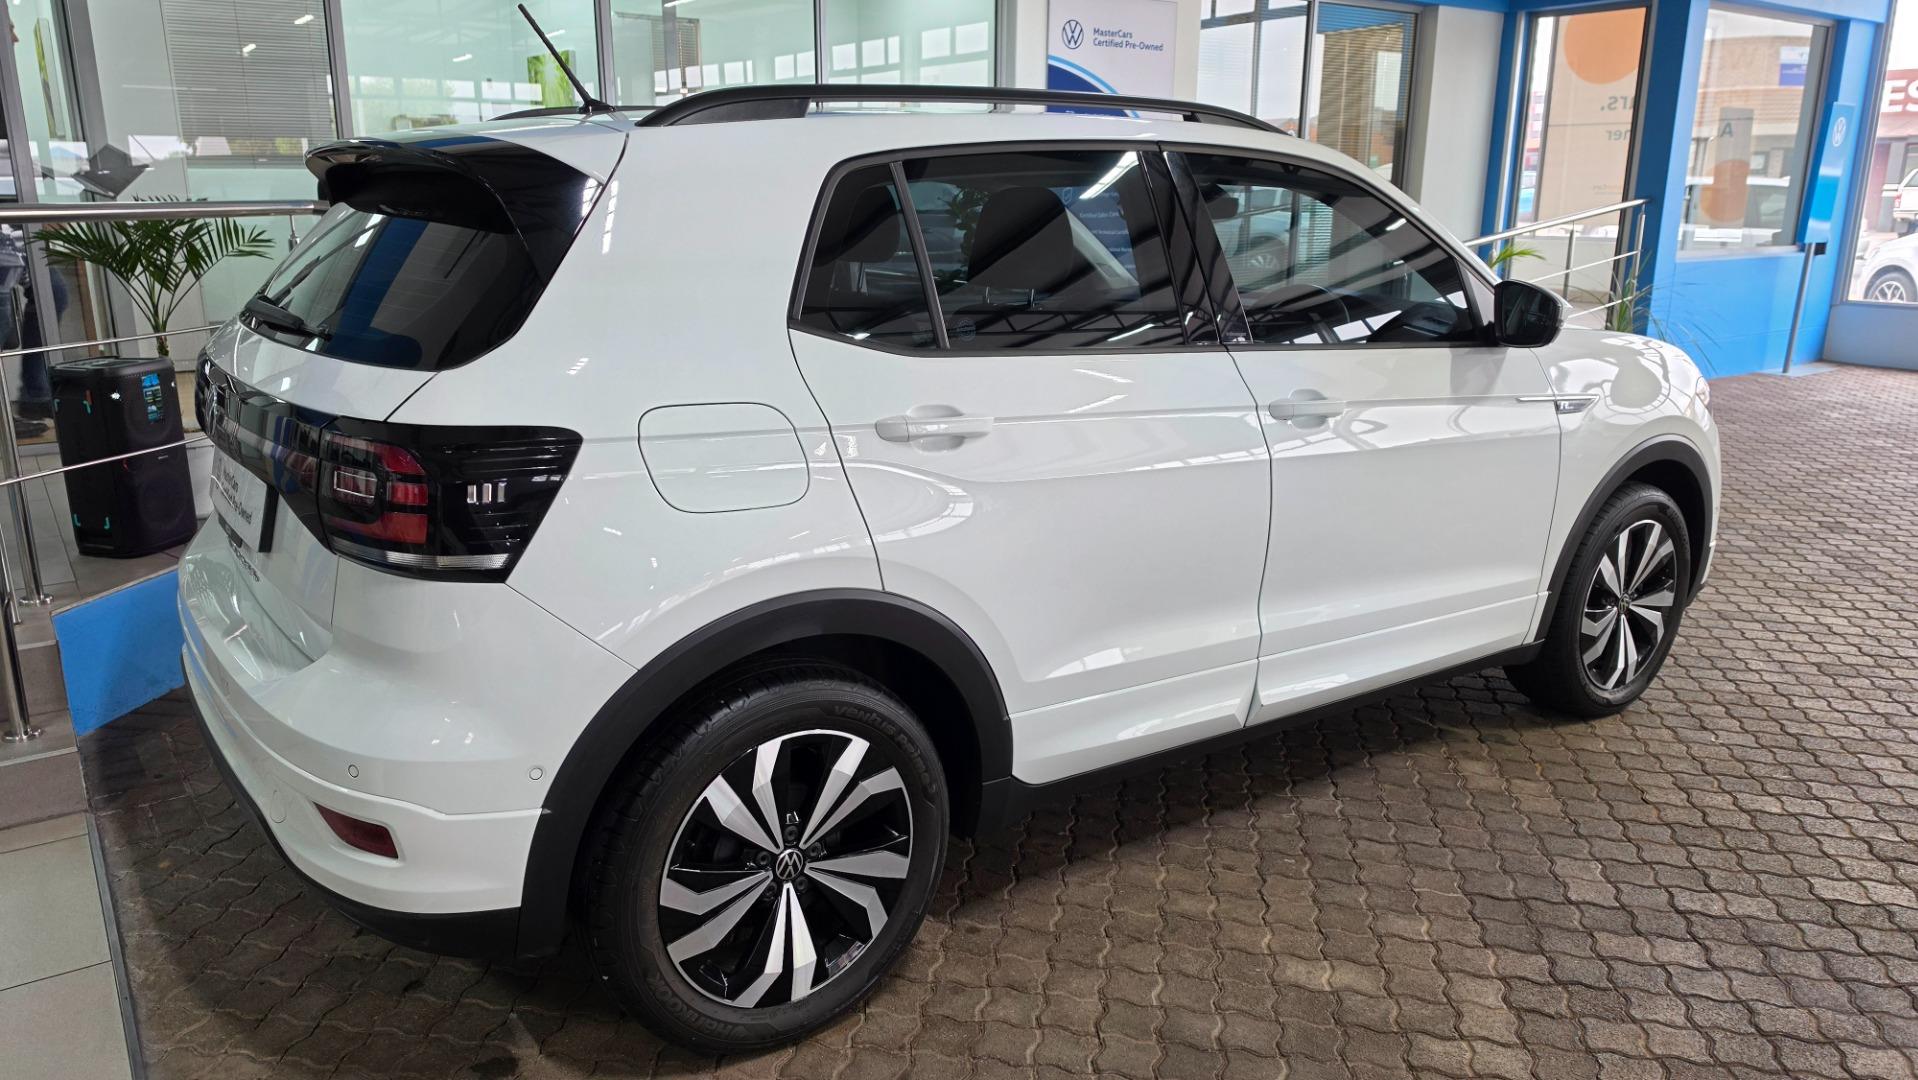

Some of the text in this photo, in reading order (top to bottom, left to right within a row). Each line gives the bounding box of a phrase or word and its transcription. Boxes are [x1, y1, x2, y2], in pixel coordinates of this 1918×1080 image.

[1093, 28, 1133, 39] MasterCars
[1093, 38, 1164, 52] Certified Pre-Owned
